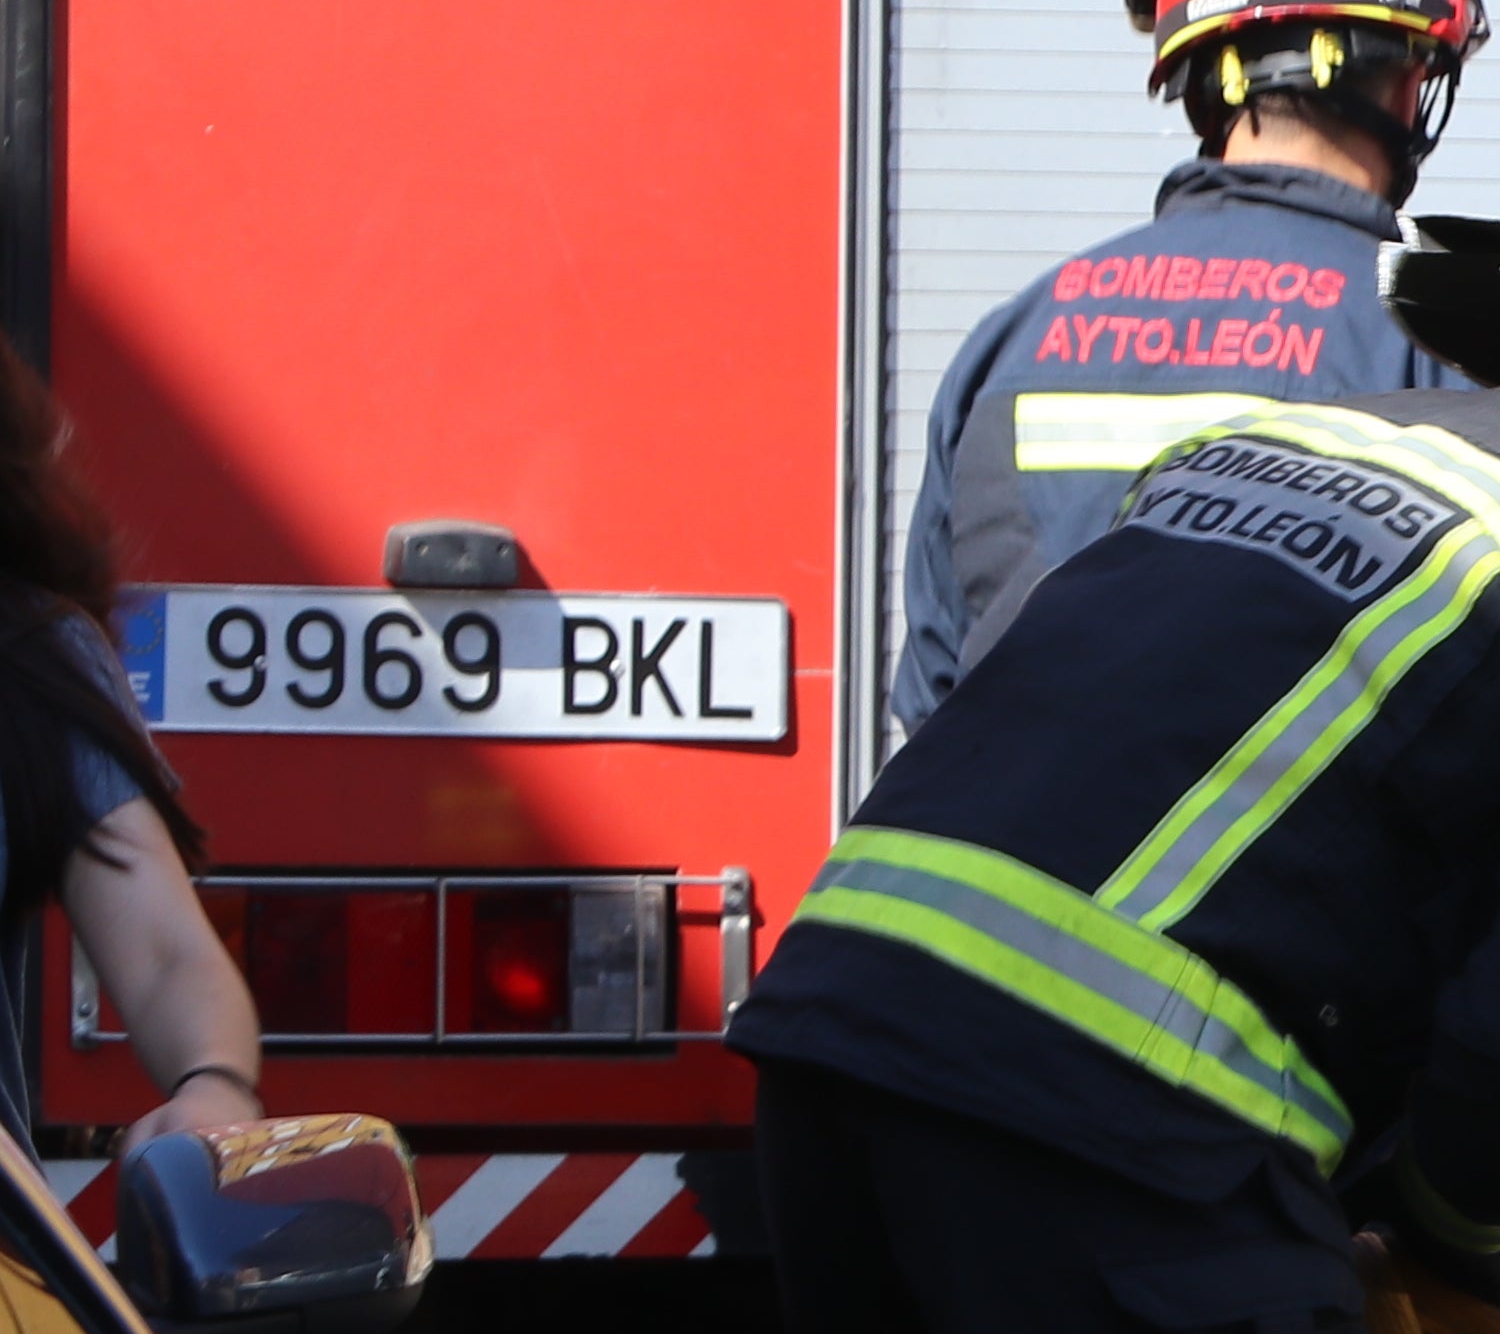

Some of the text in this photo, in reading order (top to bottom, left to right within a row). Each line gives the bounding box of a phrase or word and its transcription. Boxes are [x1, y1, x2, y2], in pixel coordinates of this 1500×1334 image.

[1053, 254, 1347, 309] BOMBEROS
[1035, 308, 1325, 376] AYTO.LEÓN
[1137, 487, 1384, 591] YTO.LEÓN
[127, 670, 151, 704] E
[206, 606, 754, 720] 9969 BKL
